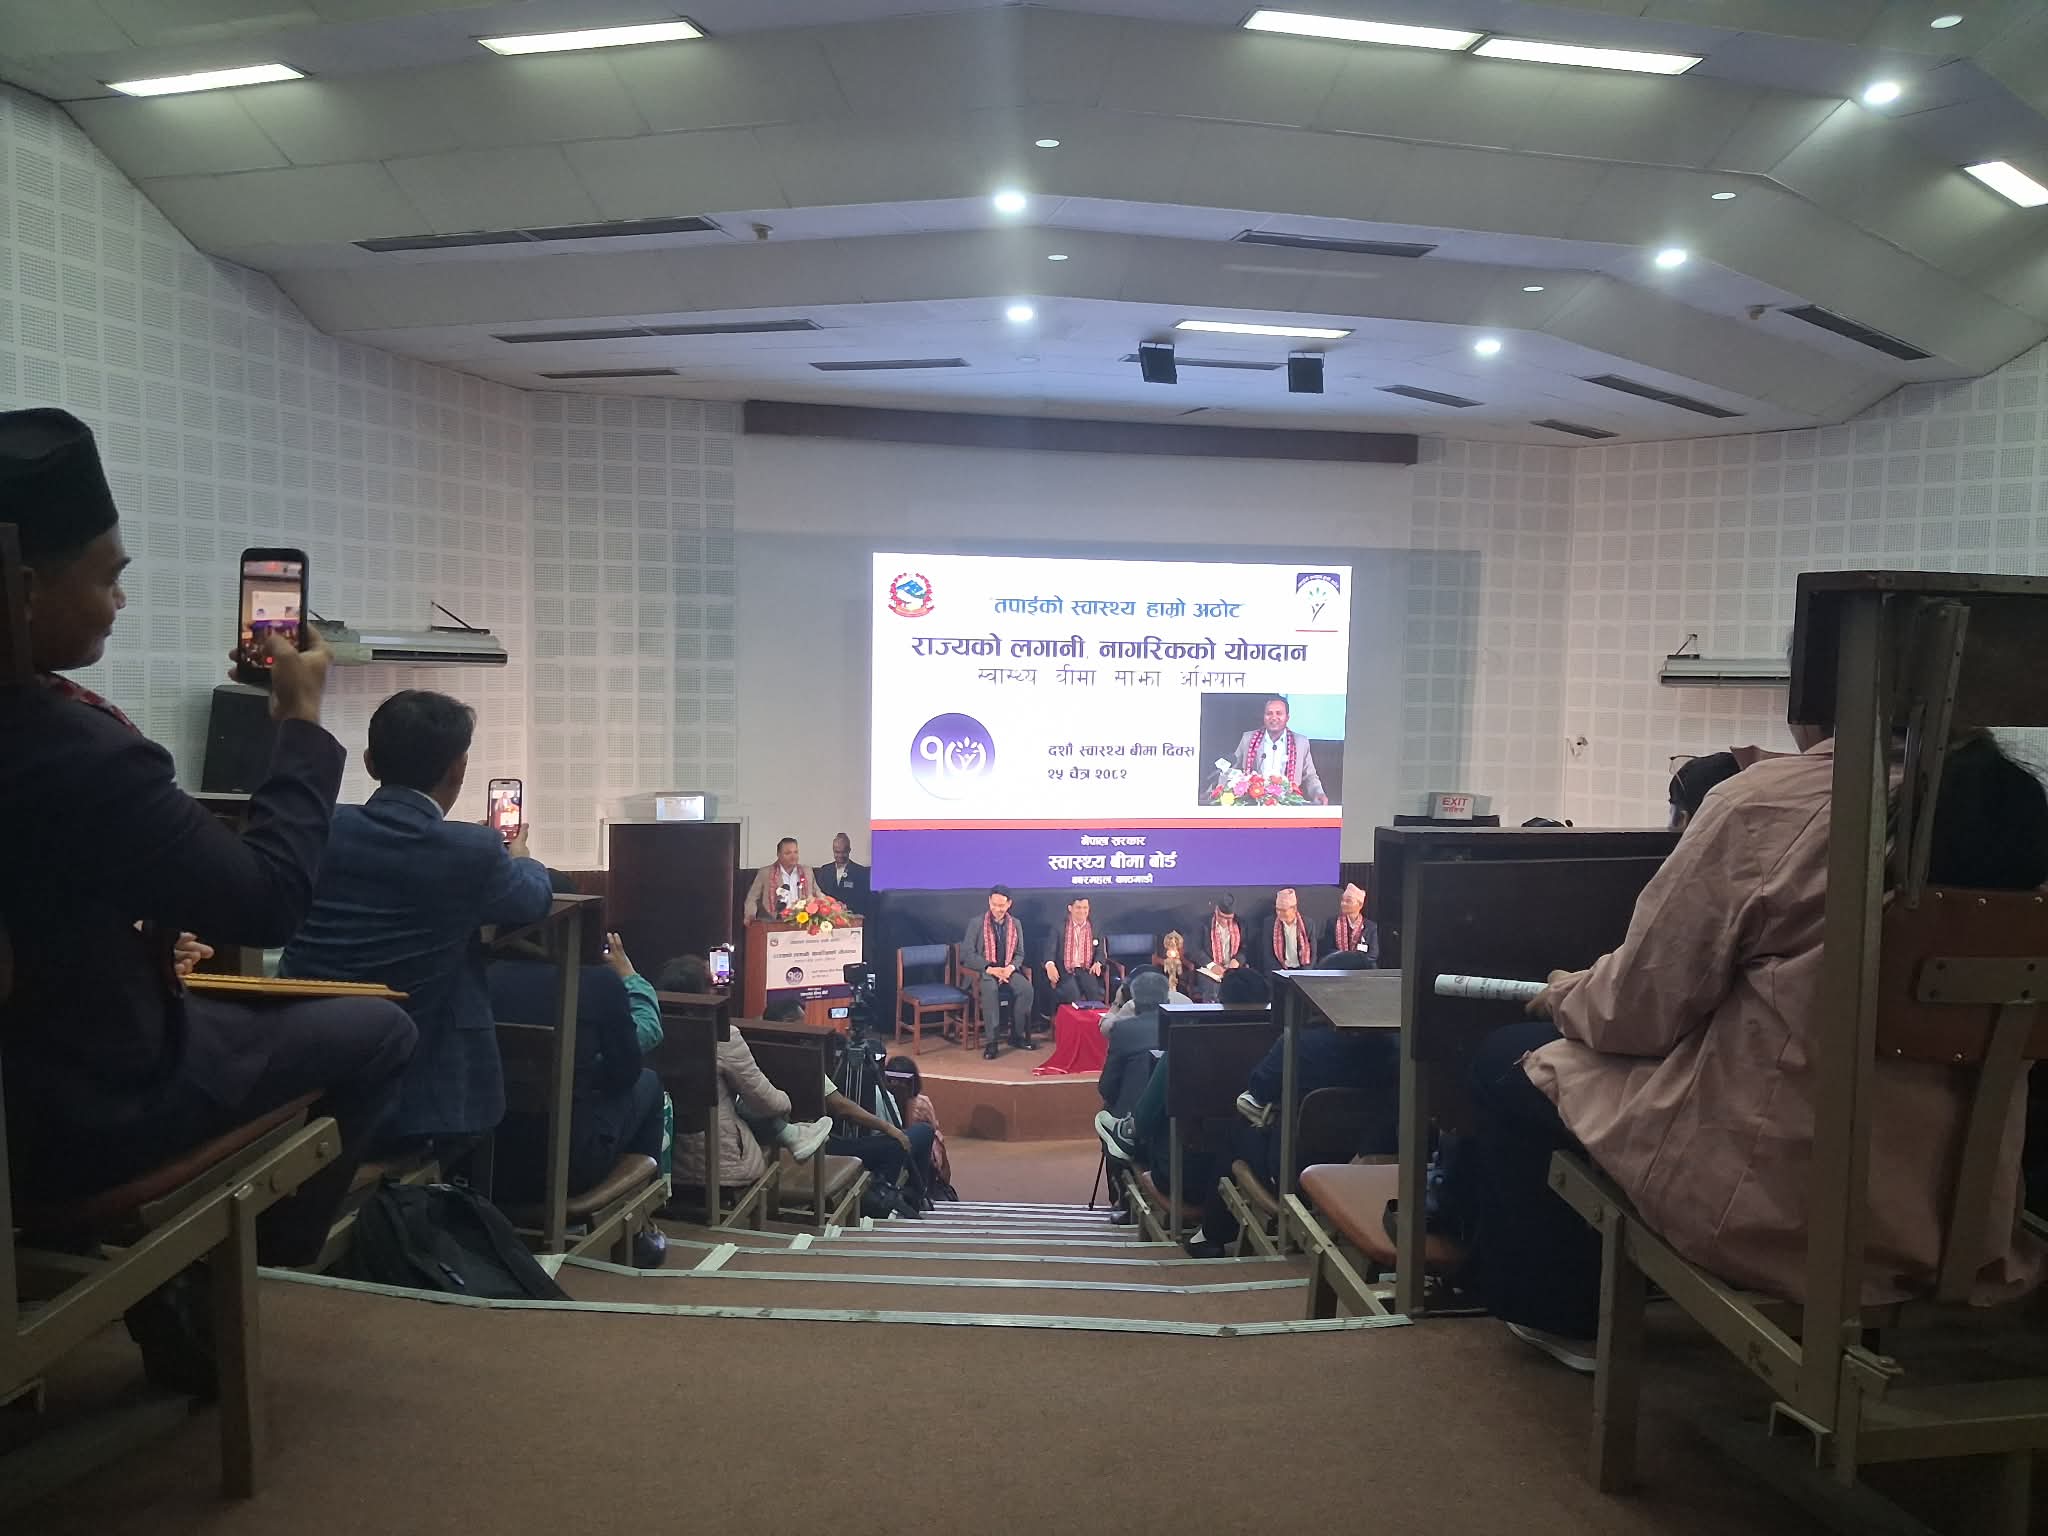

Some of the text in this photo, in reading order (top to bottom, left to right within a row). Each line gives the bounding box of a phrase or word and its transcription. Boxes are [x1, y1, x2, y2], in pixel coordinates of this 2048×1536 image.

[1071, 600, 1137, 616] स्वास्थ्य
[1146, 598, 1186, 618] हाम्रो
[911, 633, 1002, 656] राज्यको
[1099, 636, 1216, 660] नागरिकको
[1224, 637, 1308, 662] योगदान
[1079, 745, 1125, 757] स्वास्थ्य
[1129, 743, 1157, 757] बीमा
[1162, 743, 1195, 757] दिवस
[1442, 797, 1469, 807] EXIT
[1048, 850, 1178, 870] स्वास्थ्य बीमा बोर्ड
